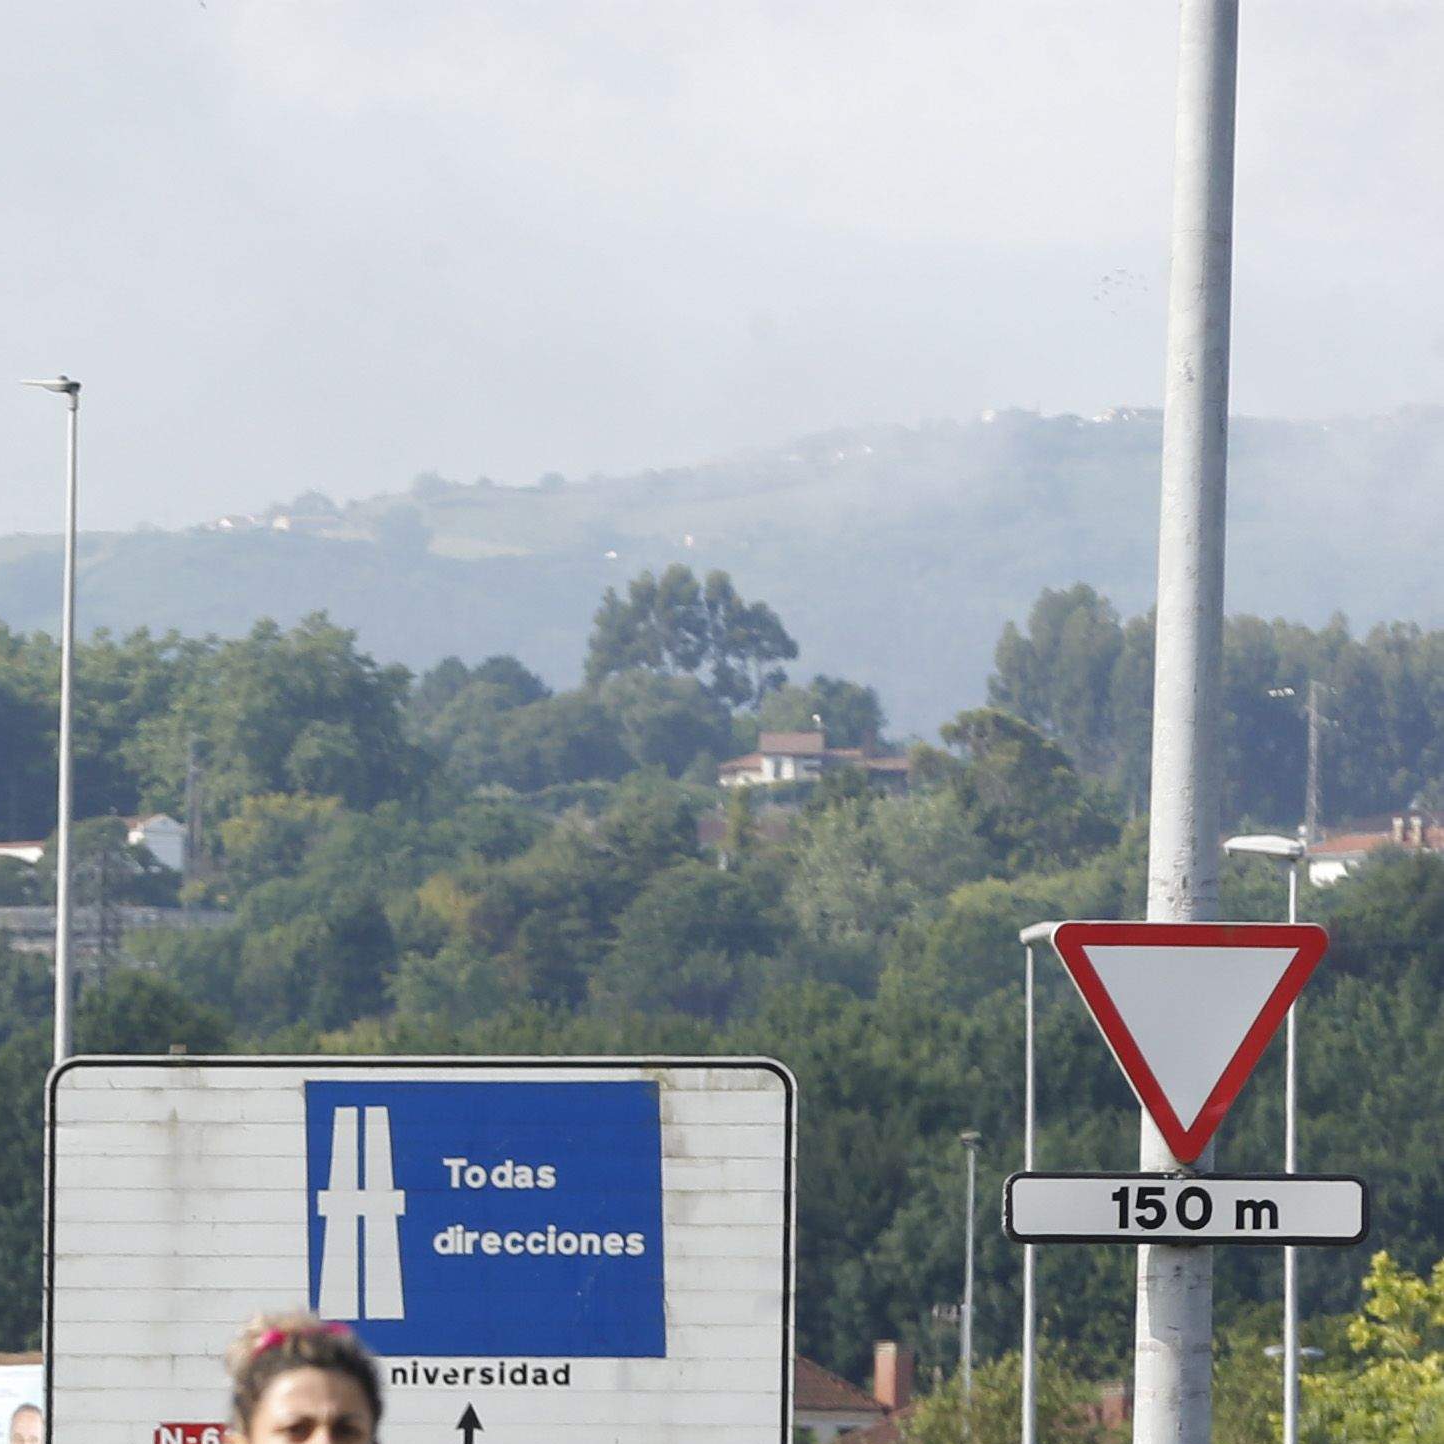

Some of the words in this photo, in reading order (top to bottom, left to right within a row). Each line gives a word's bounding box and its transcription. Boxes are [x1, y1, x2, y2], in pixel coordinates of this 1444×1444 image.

[443, 1157, 556, 1191] Todas
[1112, 1186, 1213, 1230] 150
[1235, 1198, 1279, 1230] m
[432, 1224, 645, 1257] direcciones
[390, 1361, 571, 1386] niversidad
